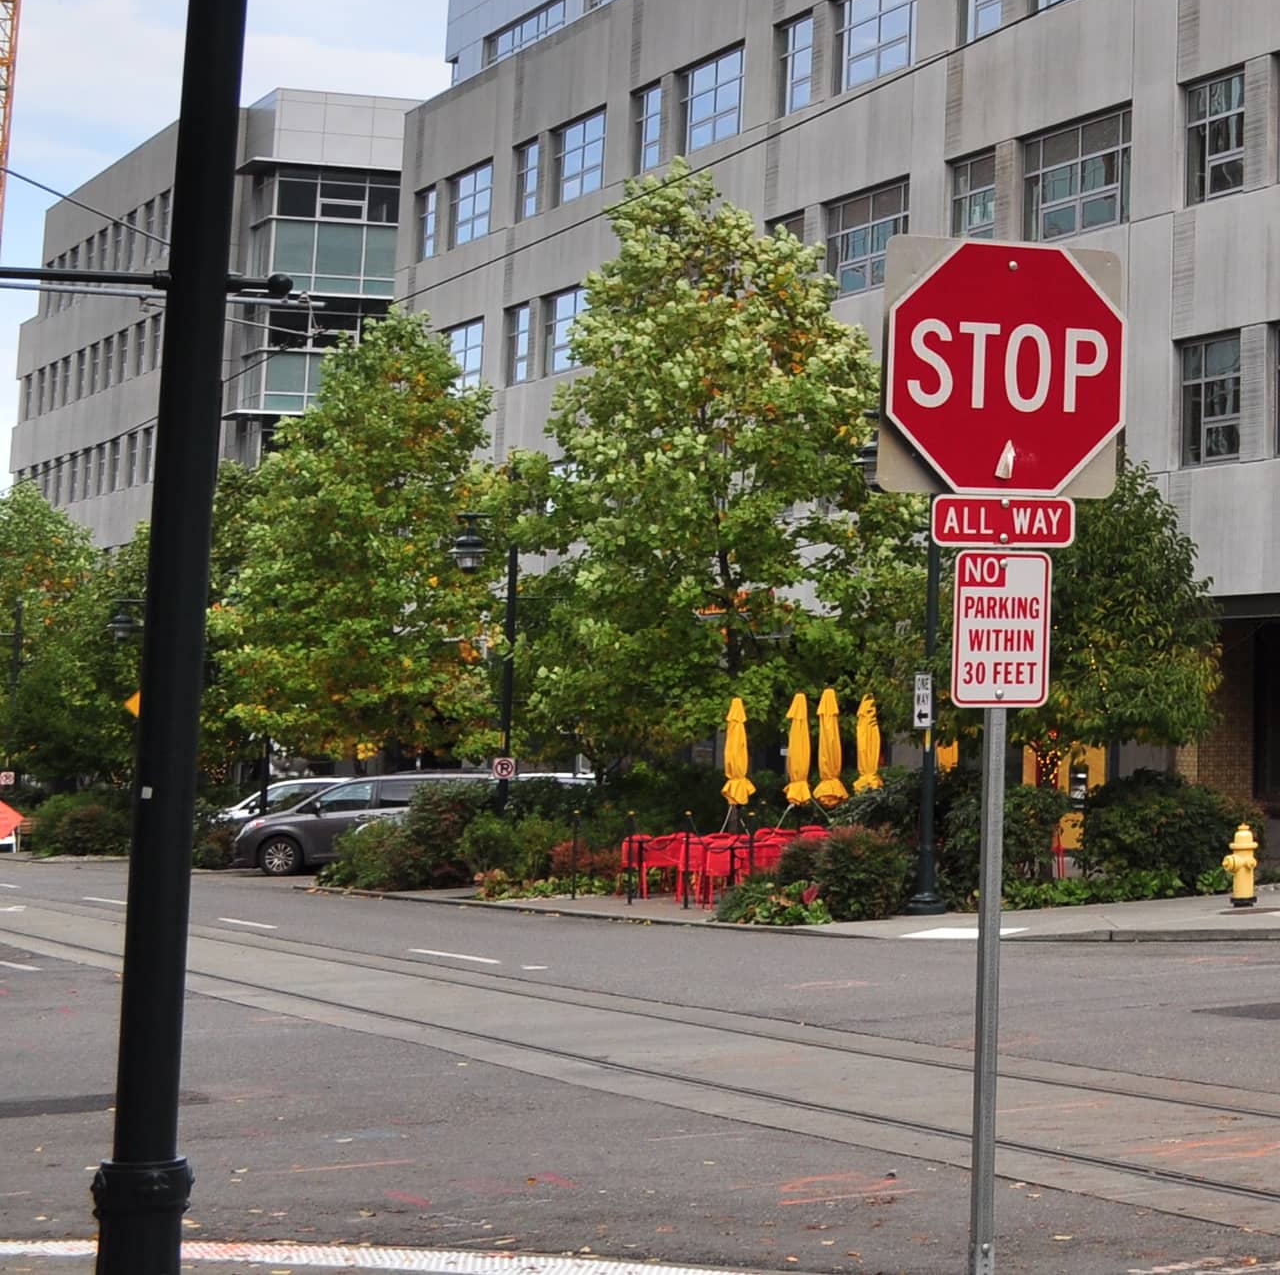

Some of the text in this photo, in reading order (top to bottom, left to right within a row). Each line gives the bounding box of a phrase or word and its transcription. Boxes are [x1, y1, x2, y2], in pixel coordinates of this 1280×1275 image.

[906, 317, 1109, 413] STOP
[943, 506, 1063, 536] ALL WAY
[964, 557, 1000, 584] NO
[964, 596, 1040, 620] PARKING
[968, 629, 1035, 653] WITHIN
[962, 661, 1038, 685] 30 FEET
